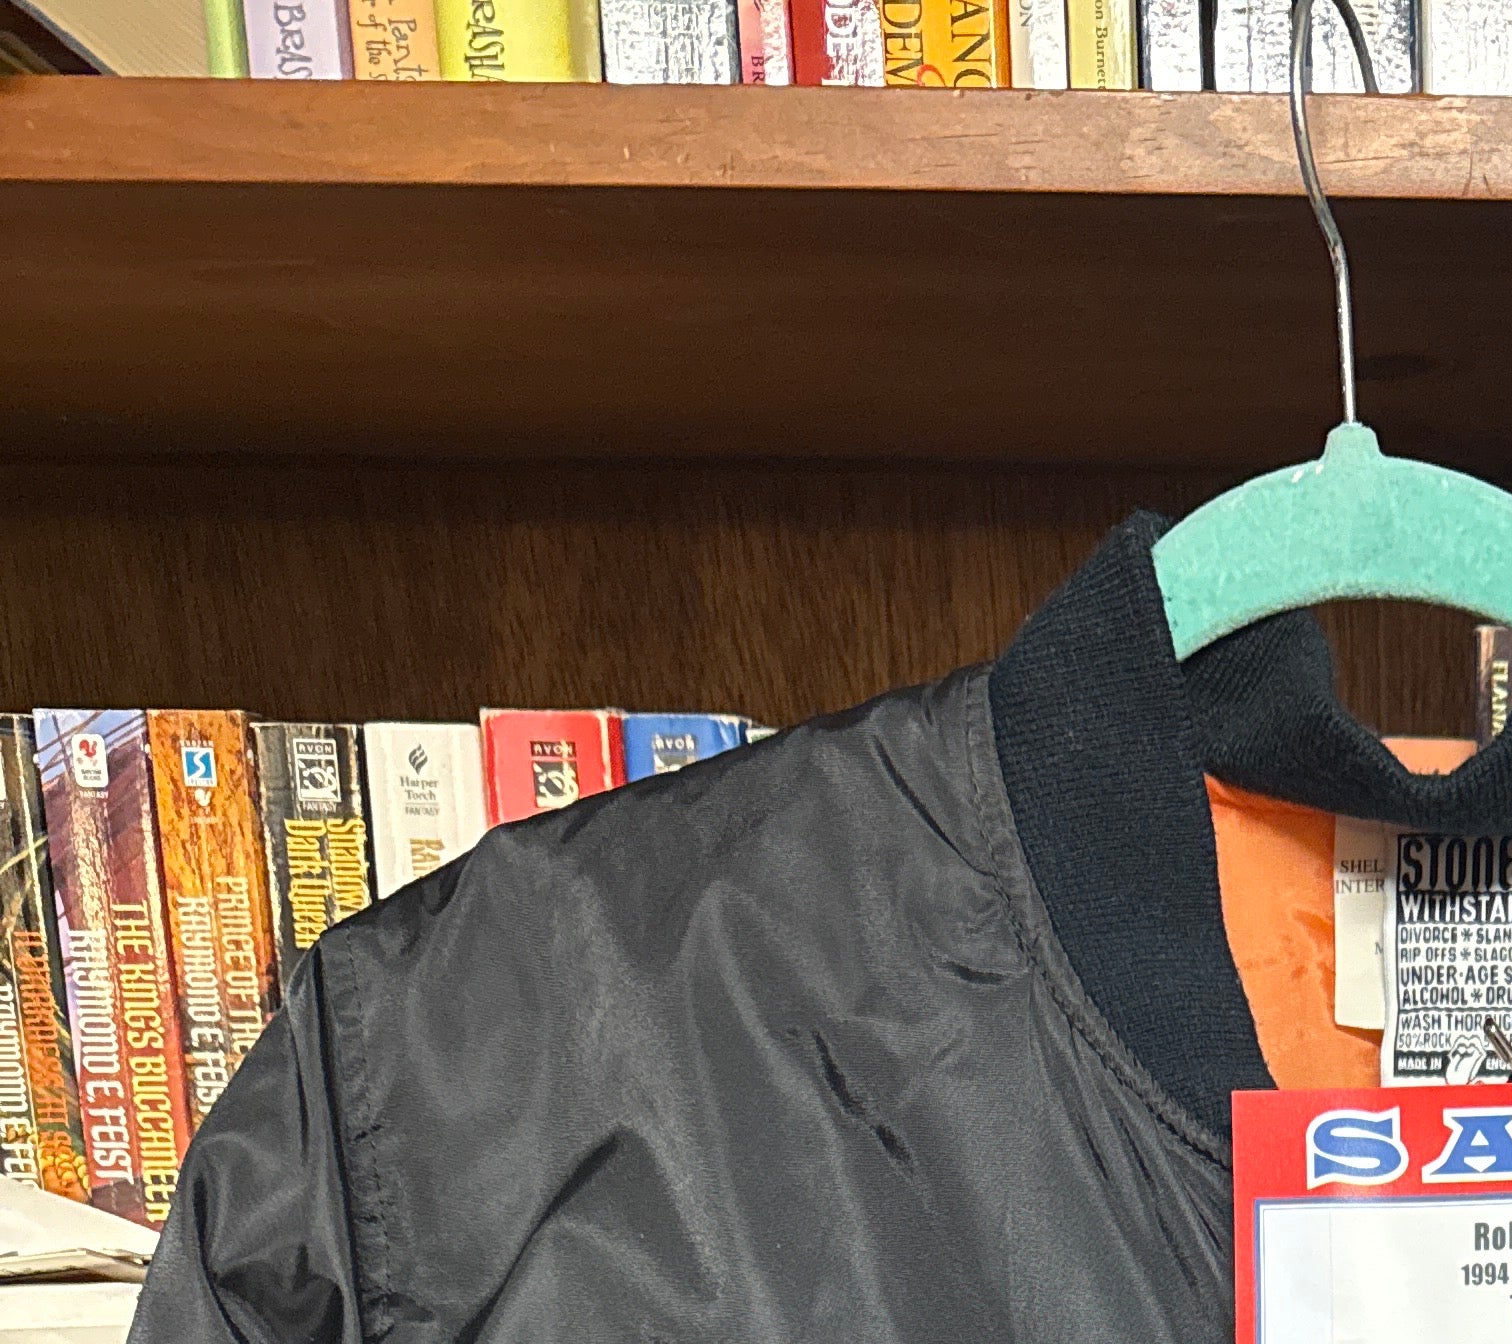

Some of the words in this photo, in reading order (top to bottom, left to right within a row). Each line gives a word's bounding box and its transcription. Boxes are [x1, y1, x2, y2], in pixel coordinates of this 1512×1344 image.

[298, 742, 333, 755] AVON
[532, 744, 574, 757] AVON
[400, 777, 439, 790] Harper
[112, 899, 154, 956] THE
[215, 875, 258, 974] PRINCE
[1400, 926, 1458, 945] DIVORCE
[177, 896, 223, 1021] RAYMOND
[1400, 946, 1421, 963] RIP
[1425, 946, 1457, 963] OFFS
[68, 928, 122, 1074] RAYMOND
[224, 976, 261, 1004] OF
[1401, 987, 1469, 1008] ALCOHOL
[1401, 1013, 1442, 1031] WASH
[1398, 1058, 1428, 1070] MADE
[1429, 1057, 1442, 1069] IN
[89, 1105, 136, 1186] FEIST
[127, 1053, 181, 1224] BUCCANEER
[1460, 1261, 1510, 1286] 1994
